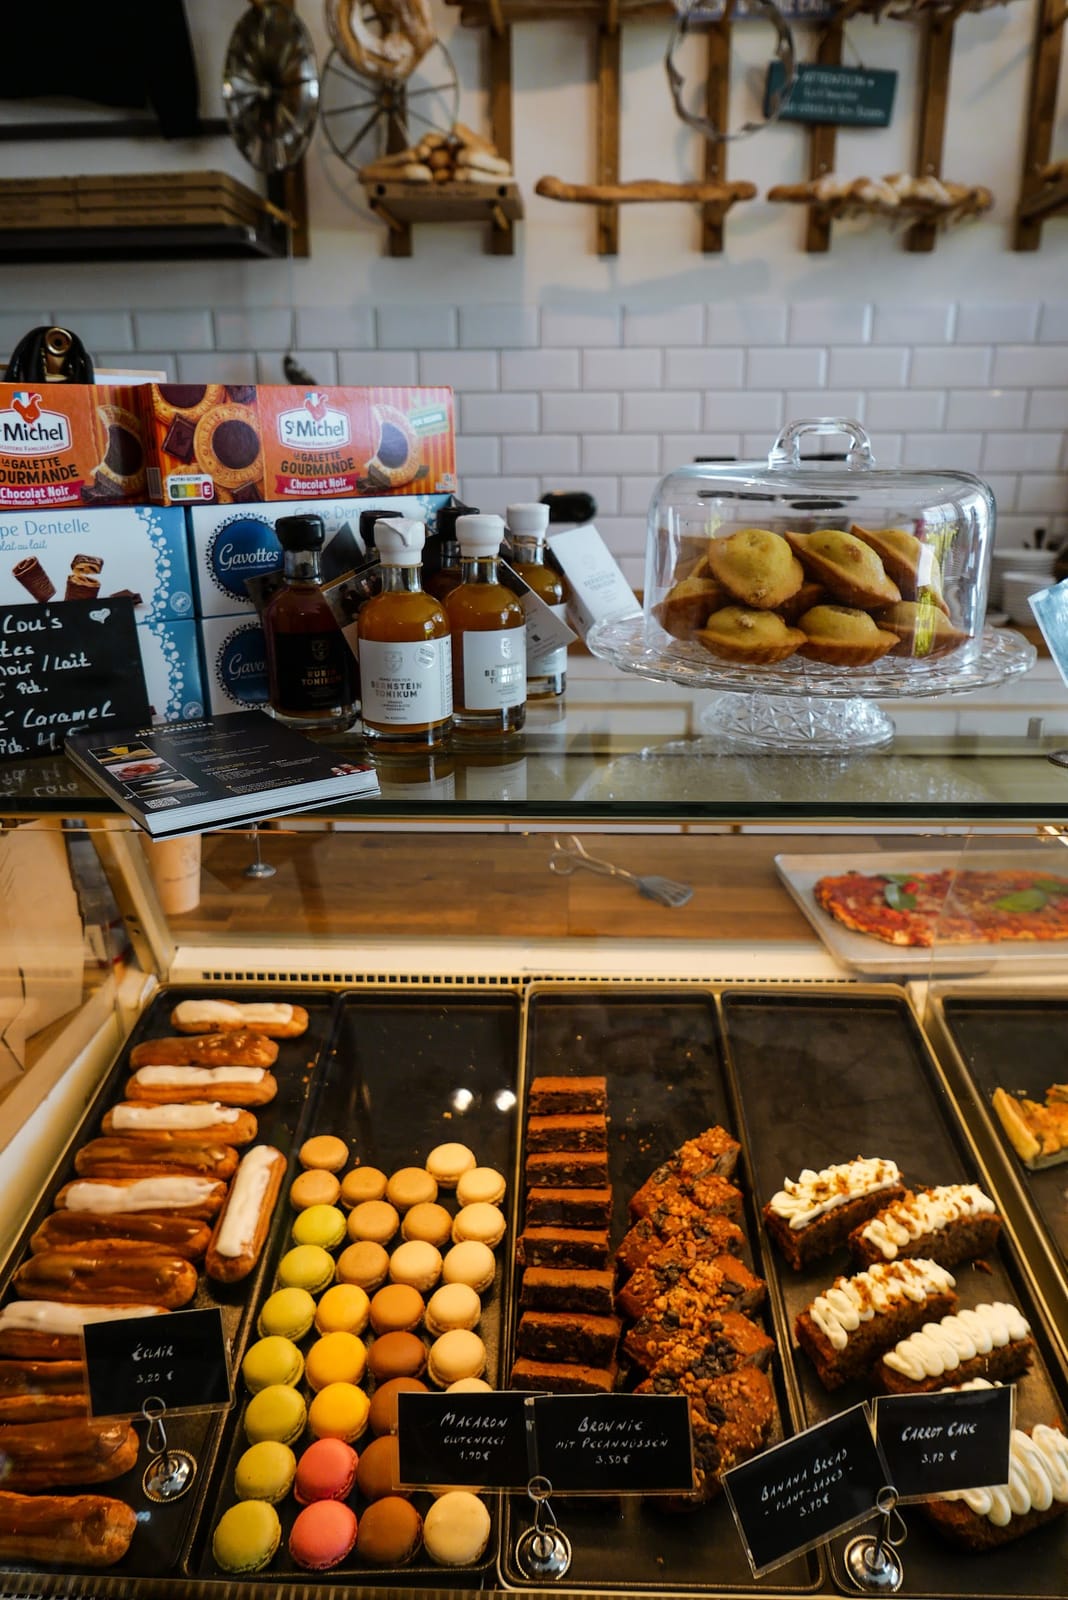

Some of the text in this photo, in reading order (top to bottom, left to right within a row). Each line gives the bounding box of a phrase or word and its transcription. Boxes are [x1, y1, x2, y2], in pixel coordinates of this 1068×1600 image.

[3, 422, 64, 441] Michel
[296, 420, 345, 437] Michel
[12, 457, 61, 470] GALETTE
[301, 451, 342, 463] GALETTE
[0, 464, 79, 484] OURMANDE
[281, 457, 356, 476] GOURMANDE
[0, 485, 69, 499] Chocolat Noir
[203, 485, 212, 495] E
[290, 477, 347, 490] Chocolat Noir
[0, 518, 91, 540] pe Dentelle
[219, 543, 280, 572] Gavottes
[3, 608, 63, 634] Lou's
[0, 640, 35, 658] tes
[229, 653, 265, 681] Gavo
[371, 681, 422, 691] BERNSTEIN
[376, 690, 418, 699] TONIKUM
[440, 1411, 508, 1428] MACARON
[901, 1421, 979, 1442] CARROT CAKE
[761, 1447, 849, 1502] BANANA BREAD
